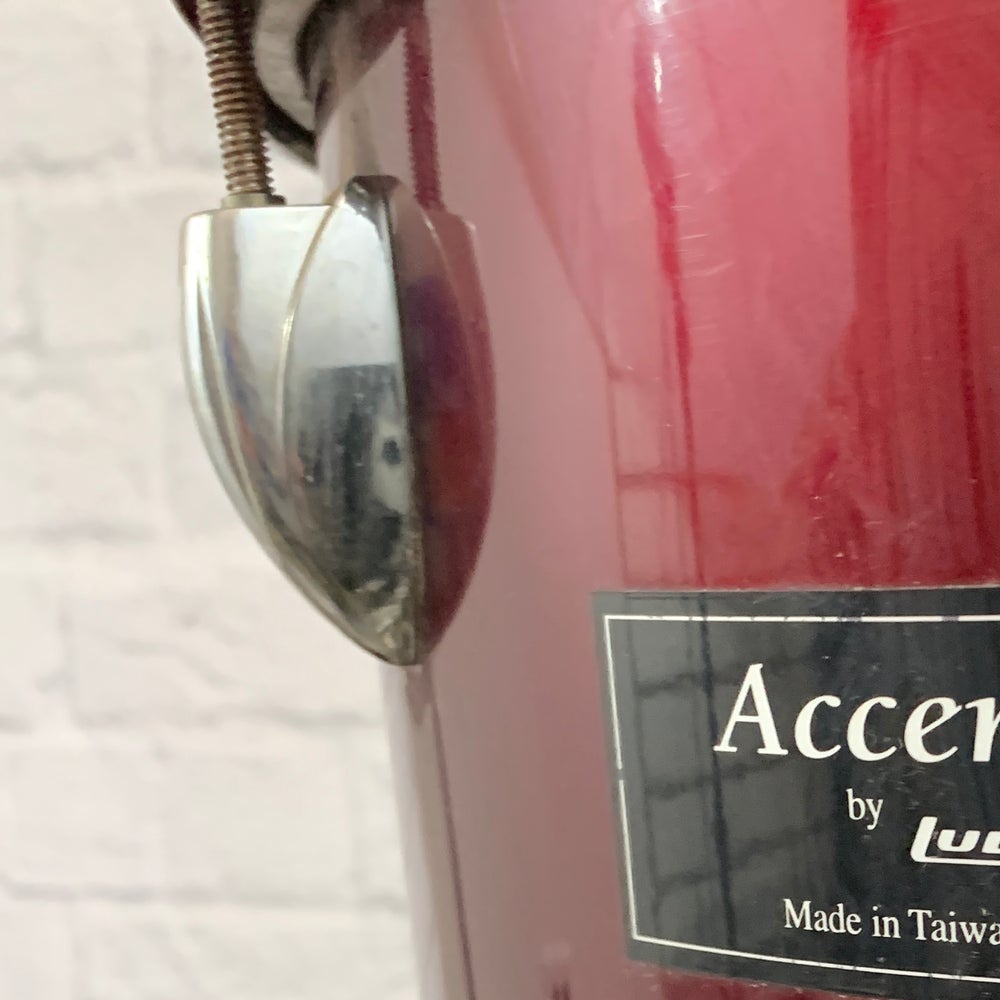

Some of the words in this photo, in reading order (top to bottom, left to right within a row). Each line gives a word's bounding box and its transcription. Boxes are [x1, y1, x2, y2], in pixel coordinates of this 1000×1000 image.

[846, 789, 884, 831] by
[783, 898, 862, 937] Made
[872, 906, 902, 939] in
